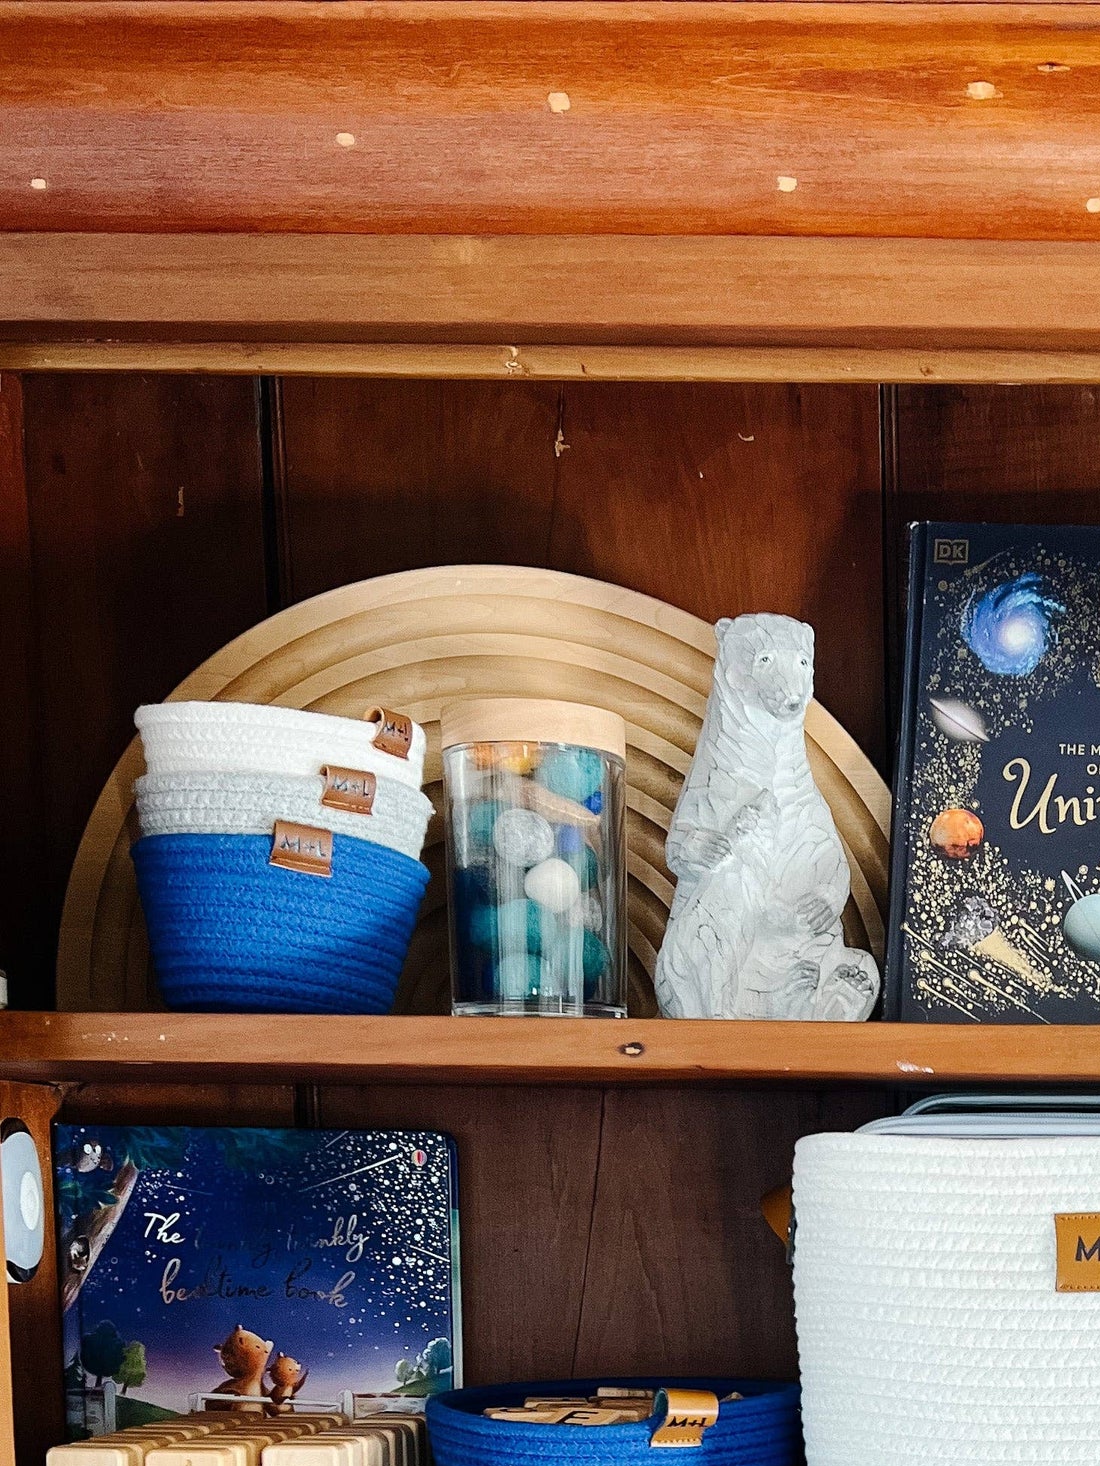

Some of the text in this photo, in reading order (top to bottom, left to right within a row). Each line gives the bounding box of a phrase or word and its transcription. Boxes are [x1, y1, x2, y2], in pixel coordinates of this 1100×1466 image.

[939, 544, 965, 559] DK
[1058, 743, 1085, 756] THE
[332, 776, 370, 798] M+L
[280, 833, 327, 857] M+L
[143, 1212, 187, 1244] The
[667, 1416, 709, 1428] M+L
